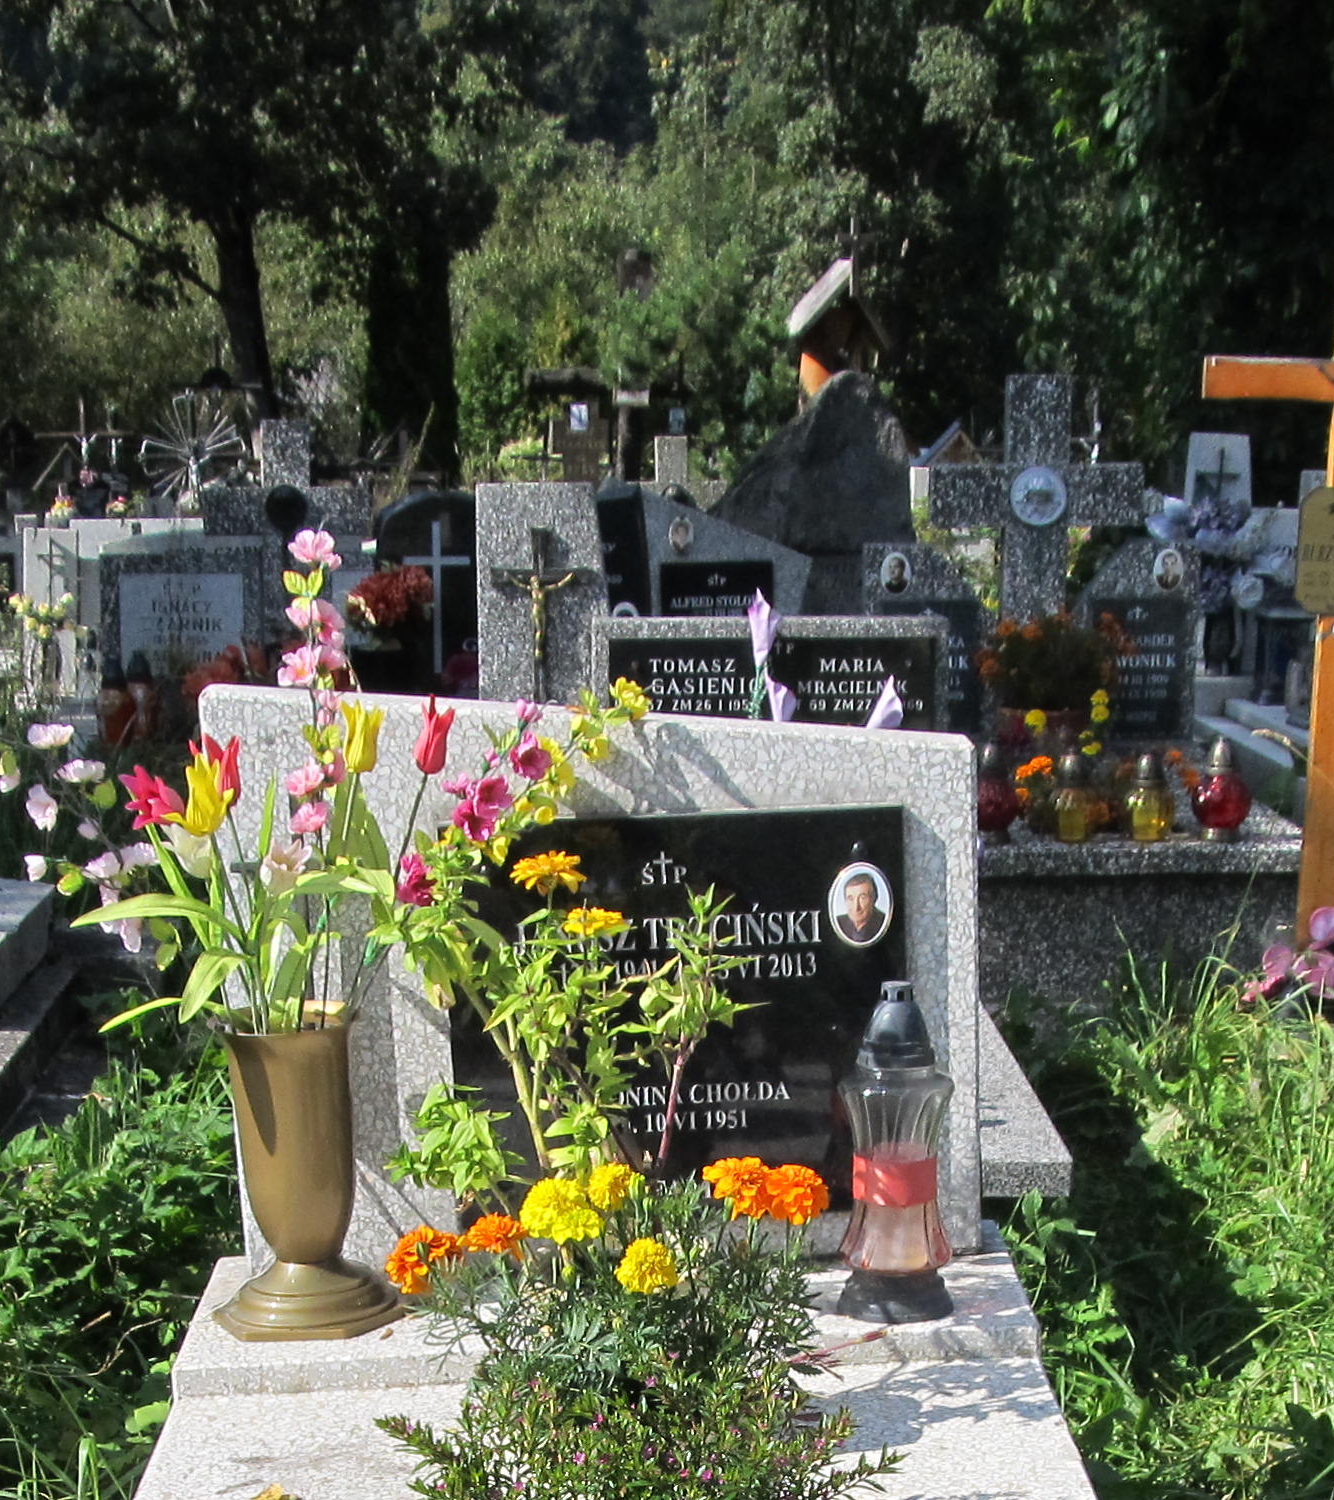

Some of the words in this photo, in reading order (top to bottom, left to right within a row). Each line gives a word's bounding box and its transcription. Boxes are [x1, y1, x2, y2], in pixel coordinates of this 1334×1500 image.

[670, 595, 714, 609] ALFRED
[649, 658, 737, 673] TOMASZ
[819, 657, 885, 674] MARIA
[768, 950, 819, 980] 2013
[689, 1080, 792, 1105] CHOŁDA
[704, 1109, 748, 1130] 1951
